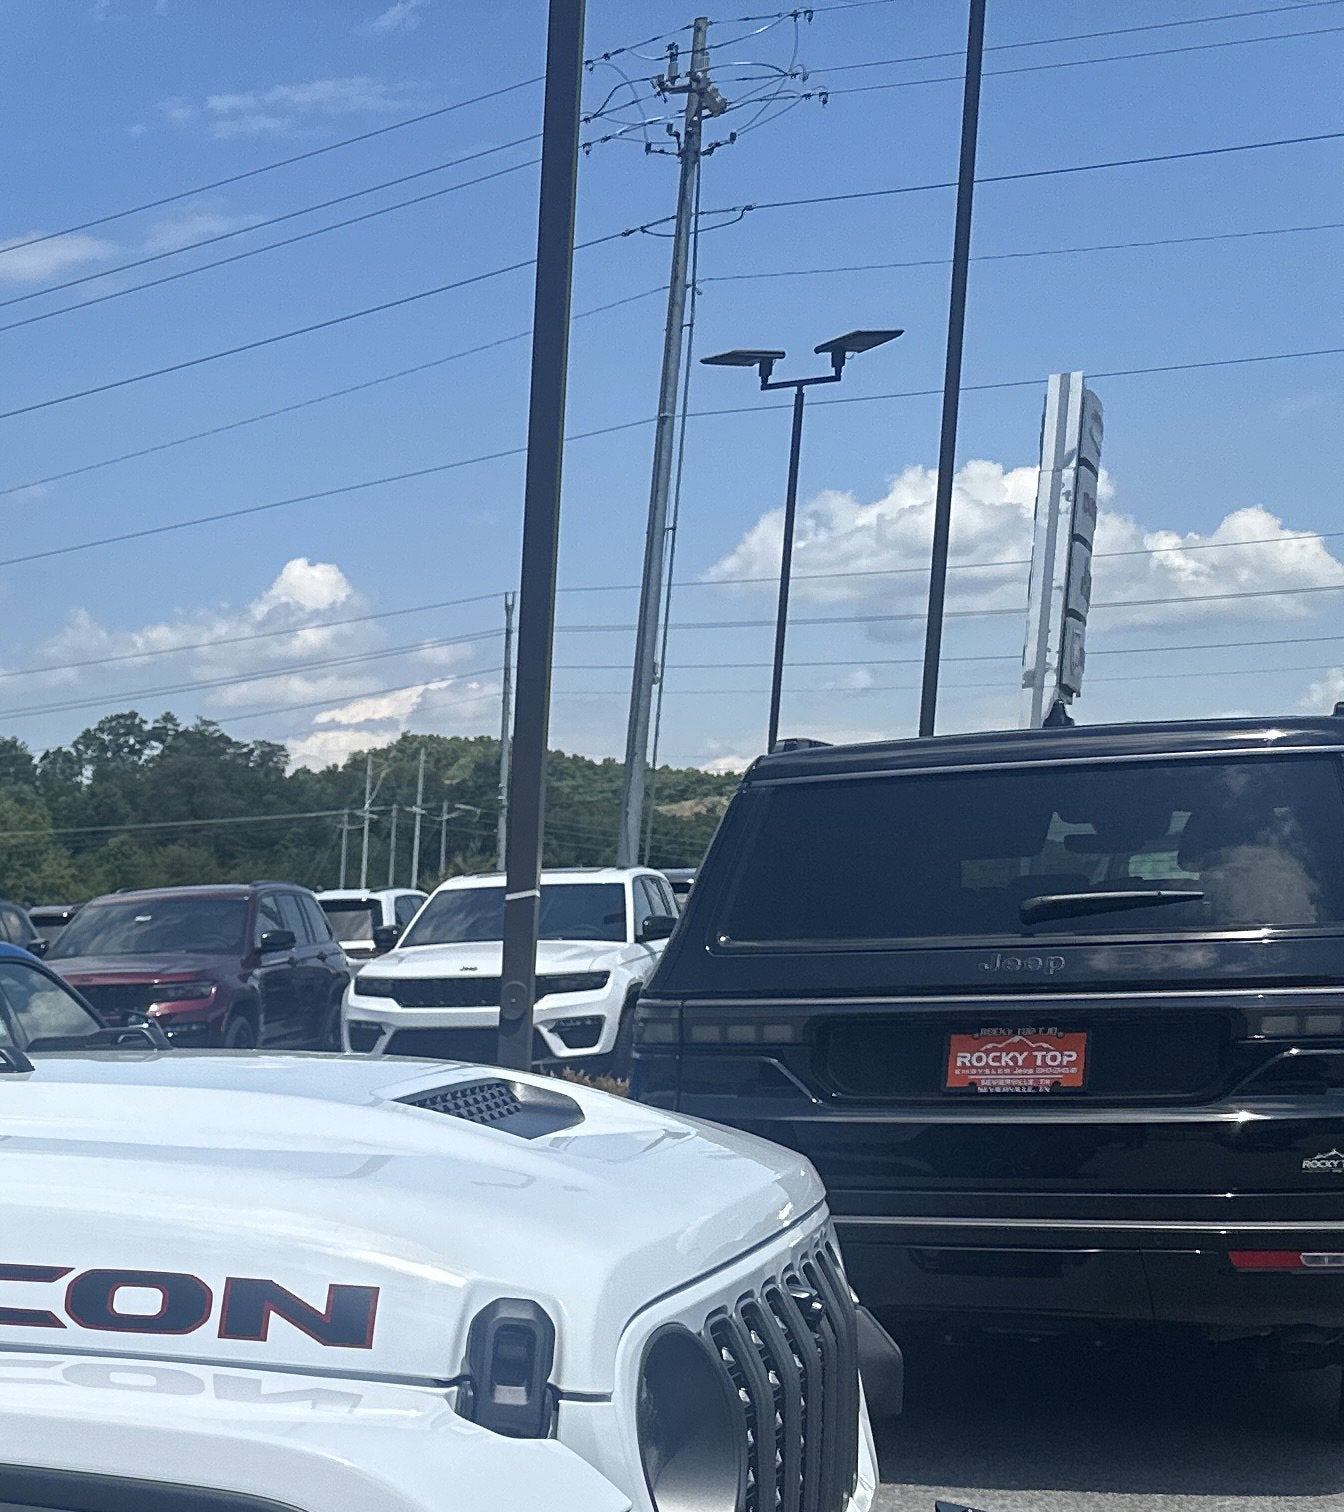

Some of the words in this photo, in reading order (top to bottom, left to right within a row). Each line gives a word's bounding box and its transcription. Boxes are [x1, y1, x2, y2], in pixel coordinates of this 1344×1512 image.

[979, 954, 1065, 974] Jeep
[956, 1051, 1029, 1067] ROCKY
[1031, 1051, 1078, 1067] TOP
